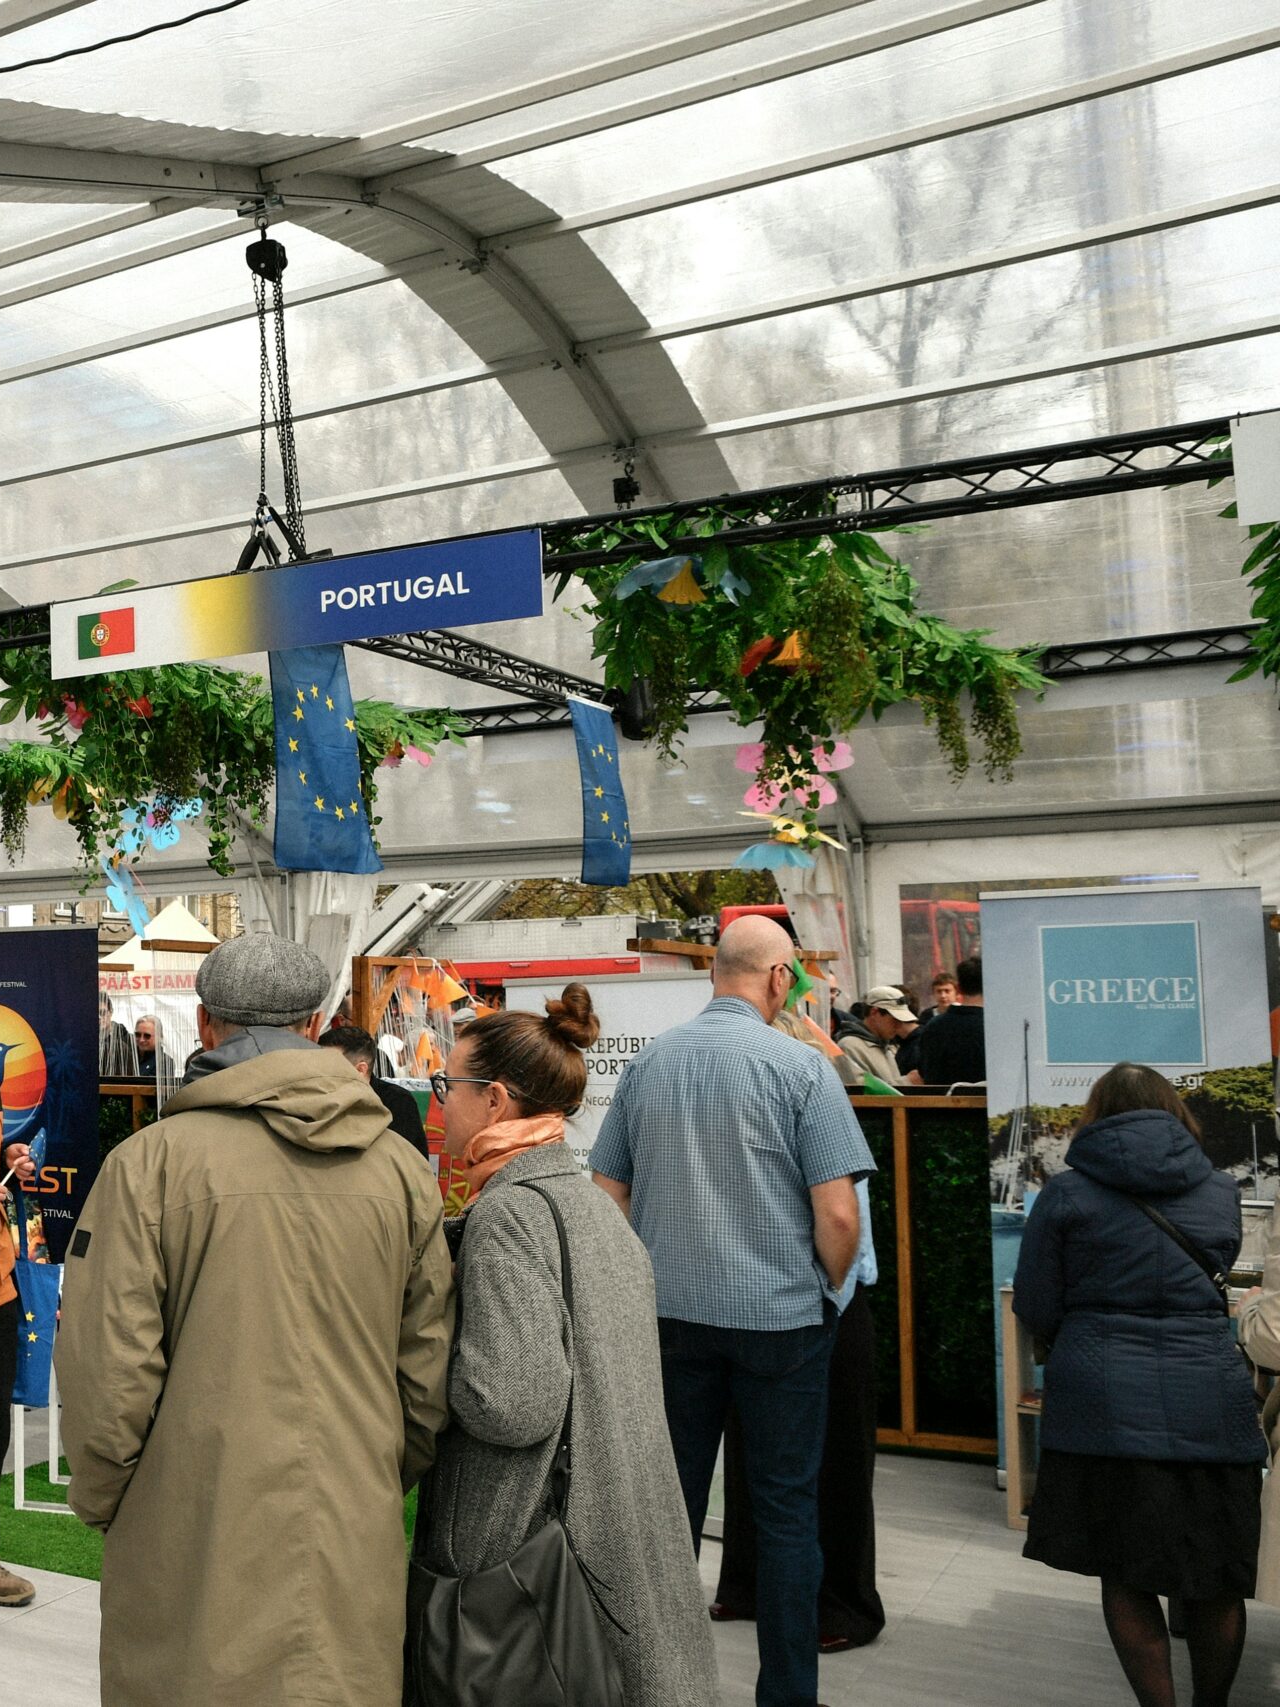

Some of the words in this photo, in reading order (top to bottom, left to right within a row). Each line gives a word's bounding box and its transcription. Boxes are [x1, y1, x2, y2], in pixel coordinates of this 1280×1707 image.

[321, 571, 470, 613] PORTUGAL
[1048, 977, 1196, 1004] GREECE
[585, 1033, 656, 1054] REPÚB
[585, 1095, 612, 1106] NEGÓ
[19, 1165, 78, 1195] EST
